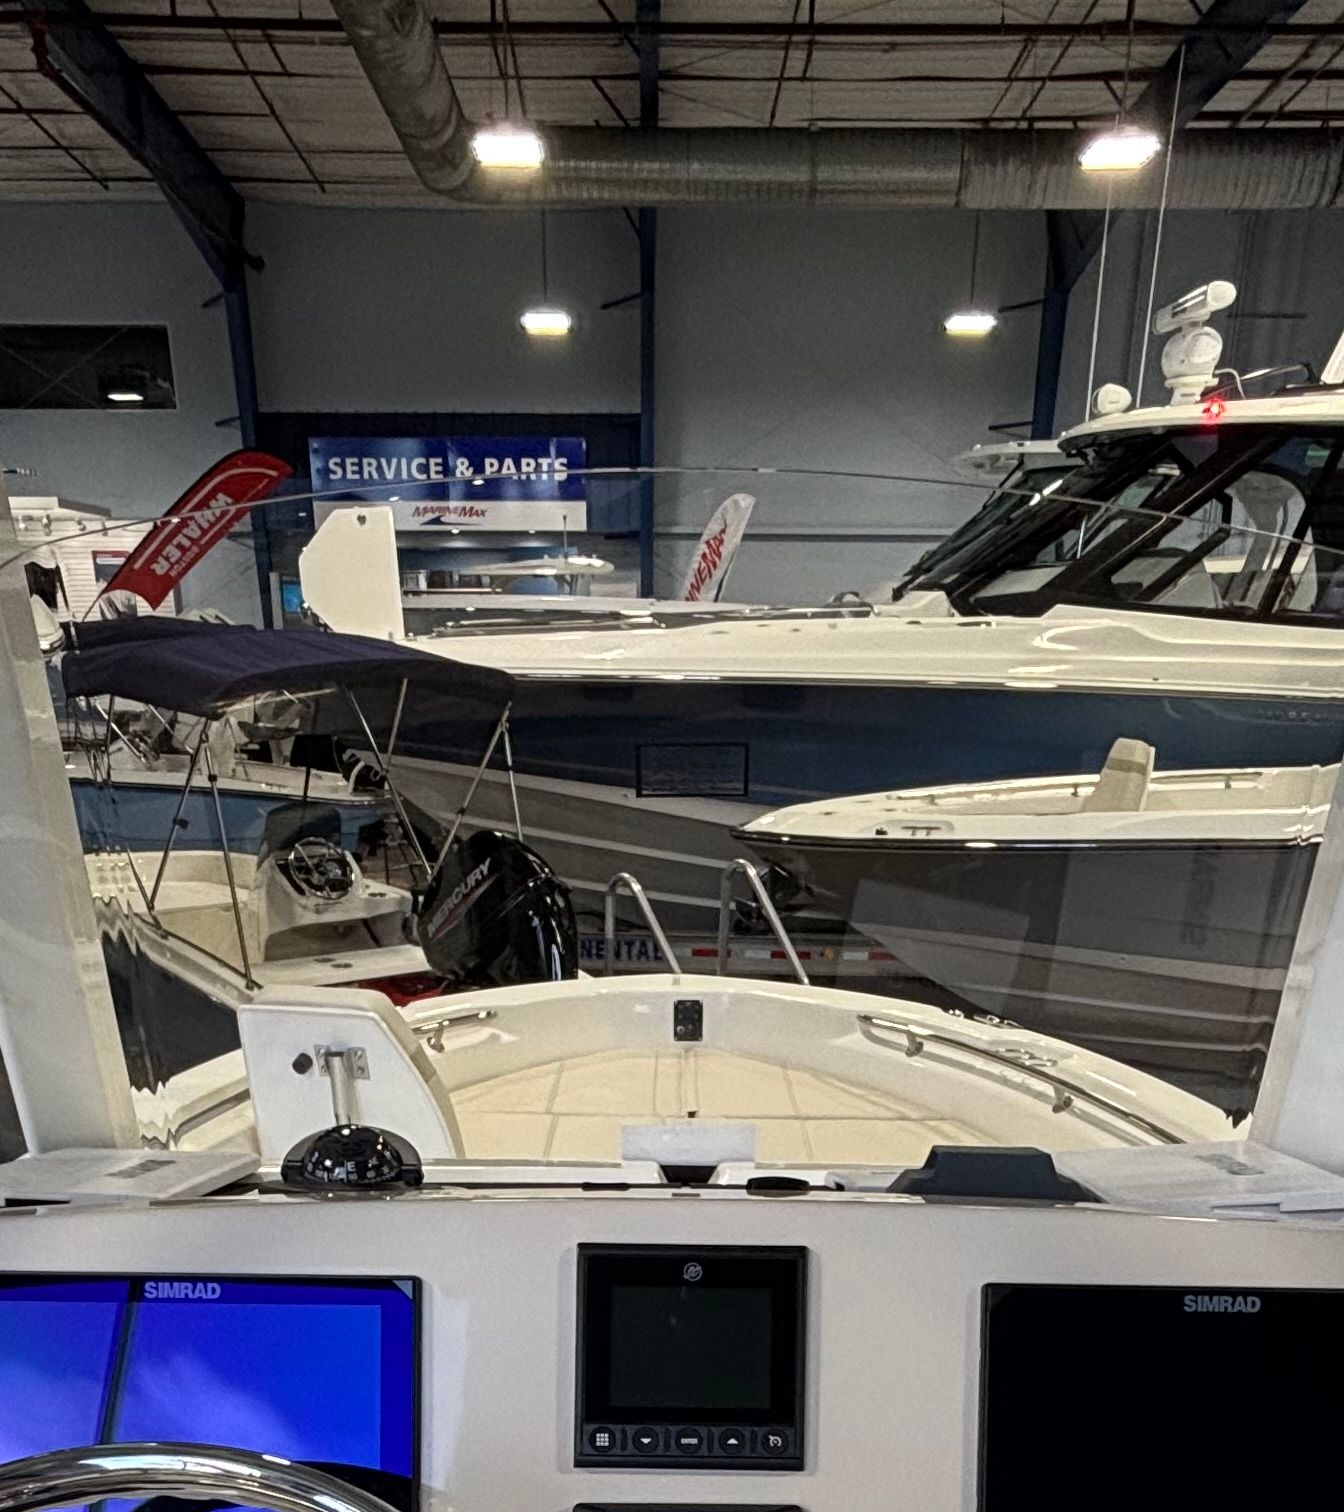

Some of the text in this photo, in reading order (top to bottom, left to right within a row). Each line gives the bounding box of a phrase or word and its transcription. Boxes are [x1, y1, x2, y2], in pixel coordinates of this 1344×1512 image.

[328, 457, 568, 481] SERVICE & PARTS
[150, 492, 234, 576] WHALER
[427, 857, 492, 940] MERCURY
[144, 1281, 221, 1300] SIMRAD
[1183, 1294, 1262, 1314] SIMRAD
